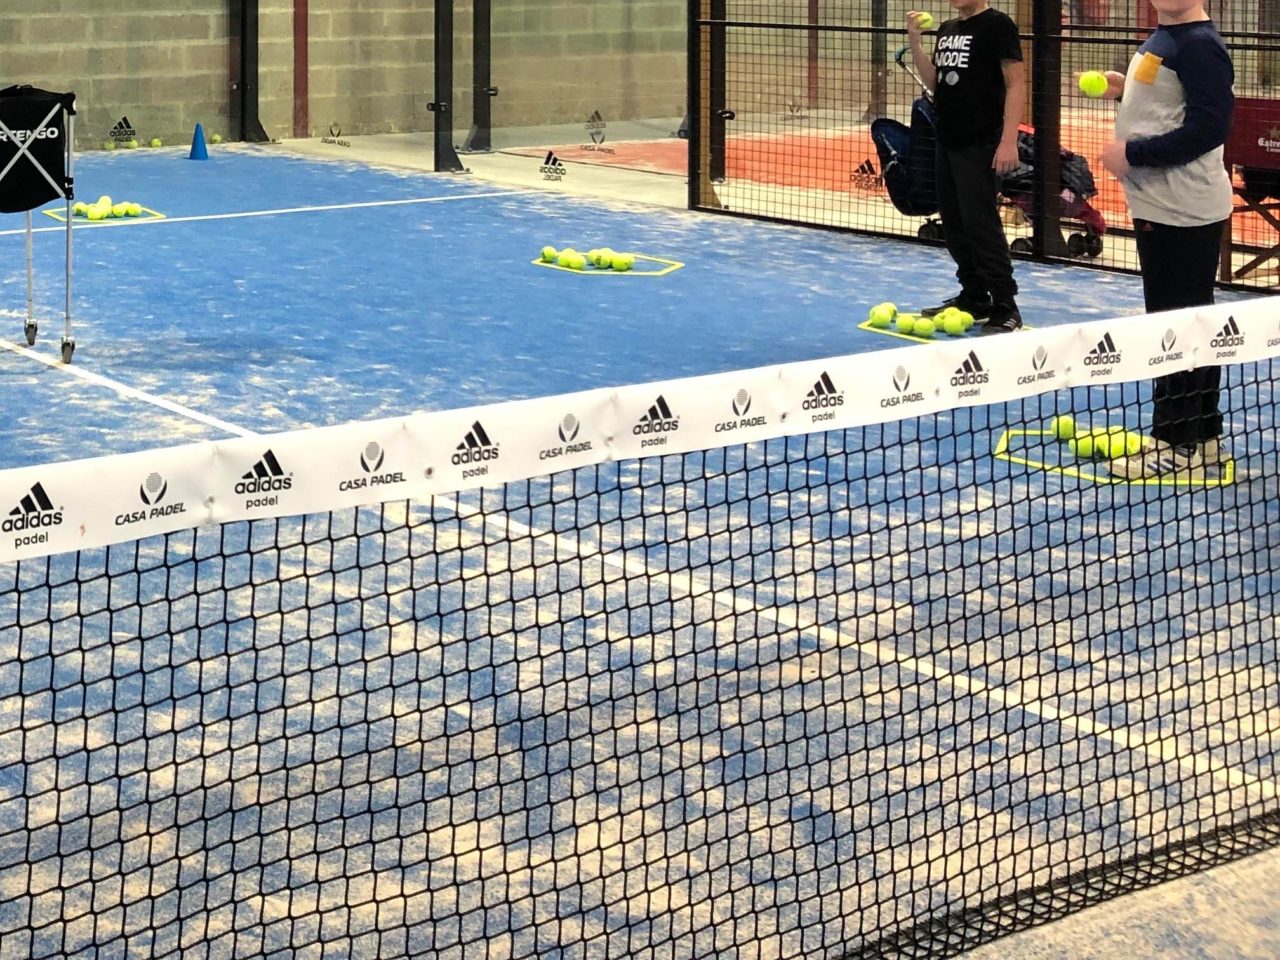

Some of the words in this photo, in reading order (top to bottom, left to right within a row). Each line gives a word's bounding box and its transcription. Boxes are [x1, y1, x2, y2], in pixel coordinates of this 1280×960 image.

[938, 35, 973, 50] GAME
[1210, 335, 1245, 348] adidas
[1083, 352, 1121, 366] adidas
[1148, 355, 1164, 366] CASA
[1165, 351, 1184, 362] PADEL
[1216, 350, 1237, 360] padel
[950, 372, 989, 387] adidas
[1017, 373, 1035, 385] CASA
[1037, 370, 1056, 381] PADEL
[1090, 367, 1112, 378] padel
[880, 397, 900, 408] CASA
[902, 392, 924, 404] PADEL
[958, 388, 981, 399] padel
[802, 394, 844, 411] adidas
[714, 421, 737, 433] CASA
[740, 416, 767, 428] PADEL
[811, 411, 835, 423] padel
[632, 419, 679, 435] adidas
[640, 436, 667, 448] padel
[451, 446, 499, 465] adidas
[539, 447, 563, 460] CASA
[565, 441, 593, 454] PADEL
[462, 465, 489, 480] padel
[234, 475, 292, 495] adidas
[339, 478, 367, 492] CASA
[370, 472, 407, 486] PADEL
[246, 495, 278, 510] padel
[1, 510, 63, 533] adidas
[115, 511, 146, 526] CASA
[149, 502, 186, 520] PADEL
[14, 532, 49, 549] padel
